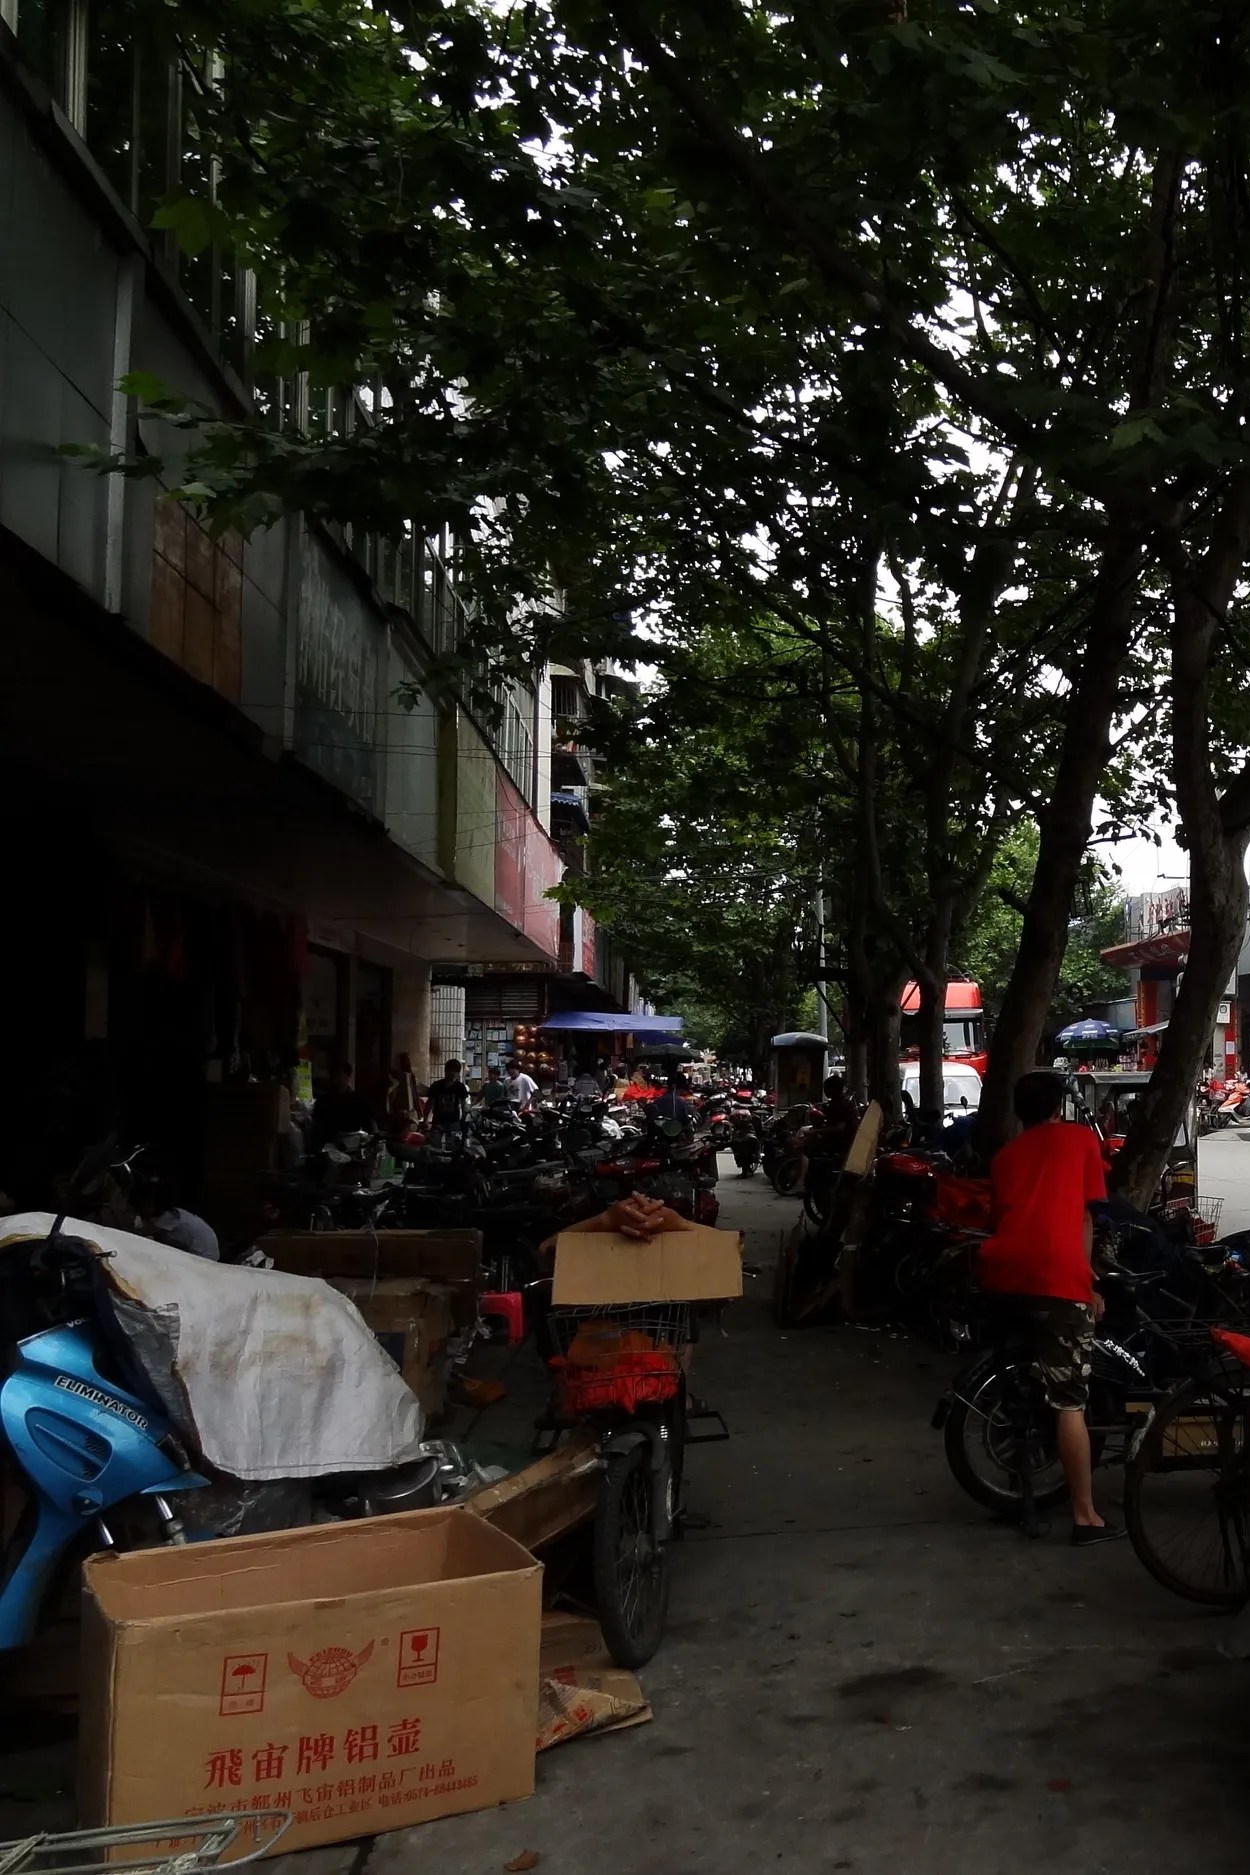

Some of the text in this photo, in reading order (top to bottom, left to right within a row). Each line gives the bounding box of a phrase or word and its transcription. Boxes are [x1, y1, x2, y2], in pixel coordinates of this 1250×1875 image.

[54, 1375, 148, 1431] ELIMINATOR
[203, 1718, 421, 1790] 飛宙牌铝壶
